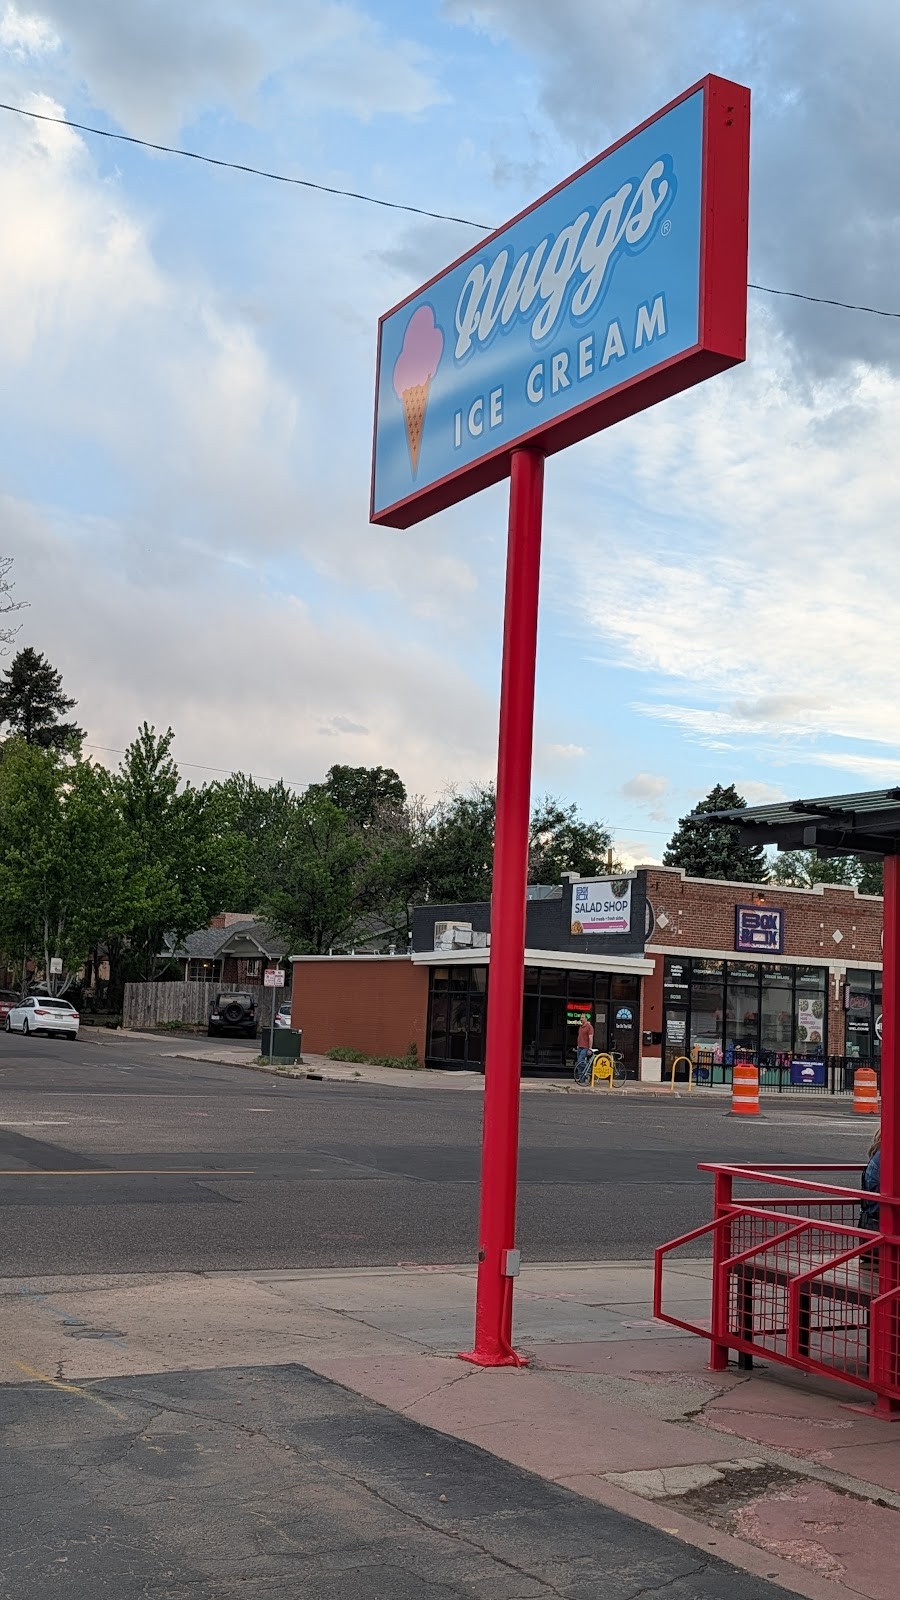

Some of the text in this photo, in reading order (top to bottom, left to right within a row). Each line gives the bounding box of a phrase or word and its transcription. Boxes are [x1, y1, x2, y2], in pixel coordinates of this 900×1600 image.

[454, 160, 668, 360] Nuggs
[455, 296, 667, 448] ICE CREAM
[575, 900, 628, 913] SALAD SHOP
